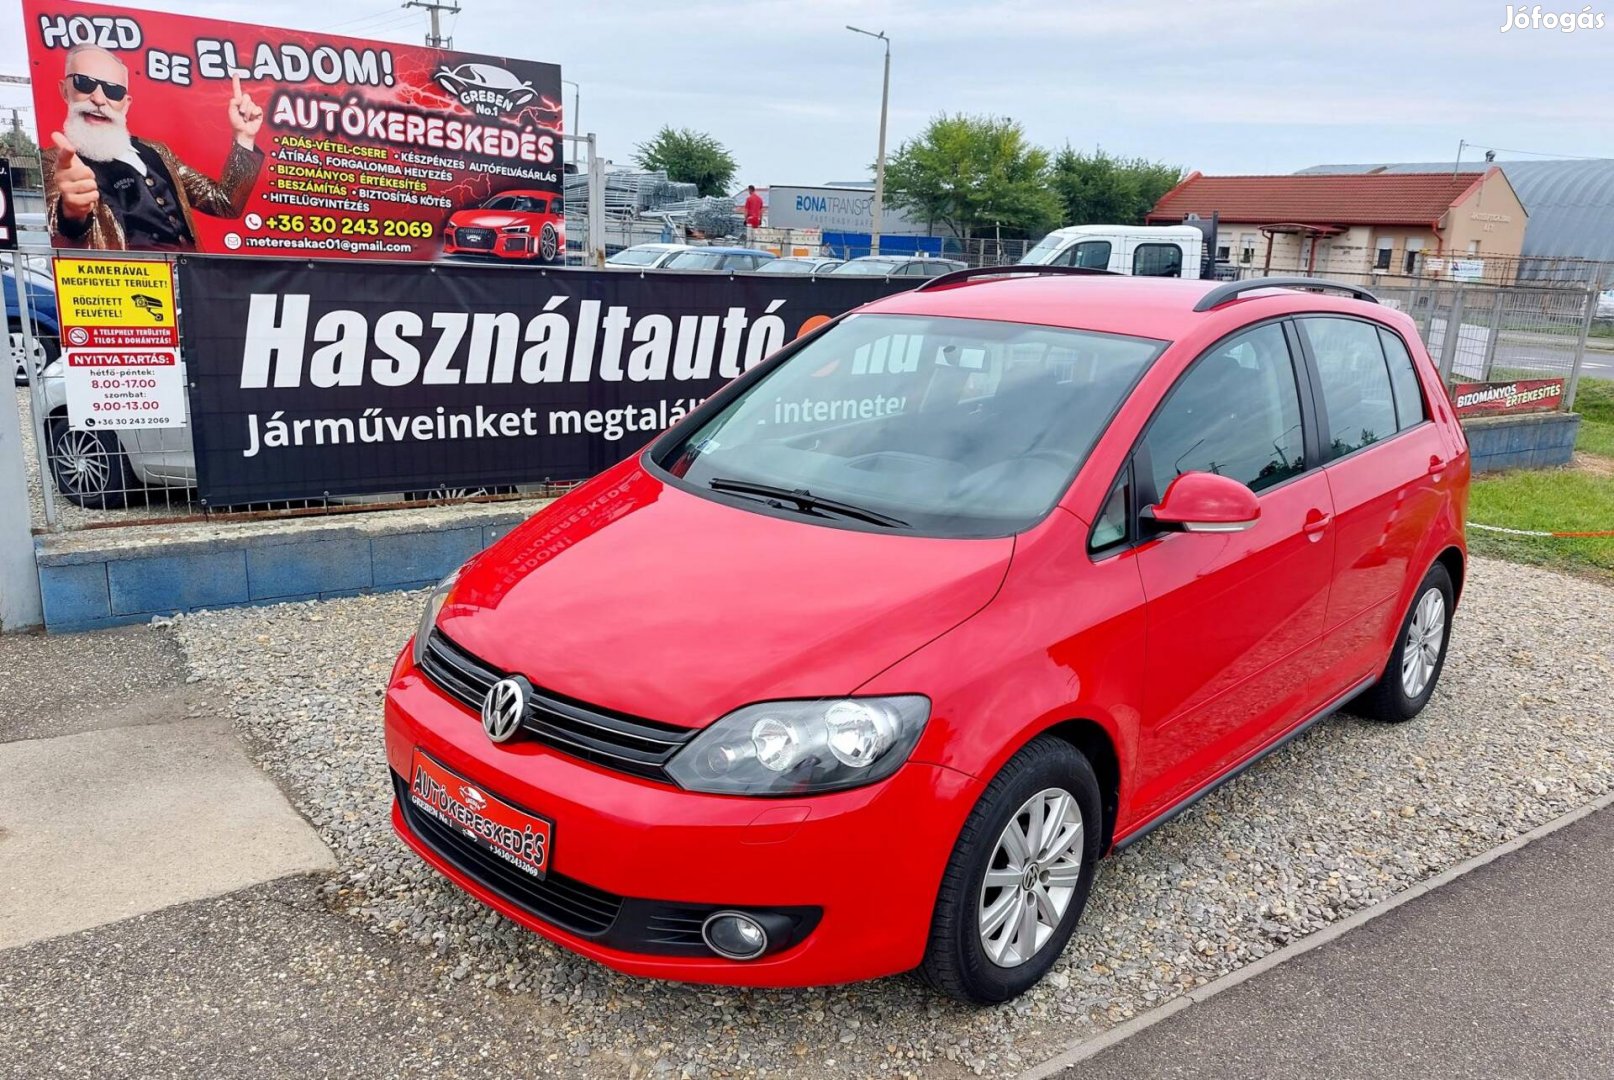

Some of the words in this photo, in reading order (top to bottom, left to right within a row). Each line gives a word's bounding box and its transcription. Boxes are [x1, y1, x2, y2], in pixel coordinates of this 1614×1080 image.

[40, 15, 142, 49] HOZD
[148, 50, 191, 85] BE
[196, 39, 394, 86] ELADOM!
[460, 90, 514, 112] GREBEN
[476, 103, 499, 117] No.1
[273, 94, 556, 165] AUTÓKERESKEDÉS
[281, 136, 388, 159] ADÁS-VÉTEL-CSERE
[278, 148, 323, 166] ÁTÍRÁS,
[325, 156, 402, 175] FORGALOMBA
[403, 167, 453, 182] HELYEZÉS
[400, 151, 466, 170] KÉSZPÉNZES
[468, 161, 558, 183] AUTÓFELVÁSÁRLÁS
[277, 164, 355, 183] BIZOMÁNYOS
[359, 173, 427, 192] ÉRTÉKESÍTÉS
[270, 192, 370, 212] HITELÜGYINTÉZÉS
[277, 179, 348, 196] BESZÁMÍTÁS
[358, 188, 418, 204] BIZTOSÍTÁS
[418, 194, 452, 208] KÖTÉS
[266, 214, 305, 233] +36
[308, 216, 337, 234] 30
[341, 218, 379, 235] 243
[383, 220, 433, 238] 2069
[77, 264, 150, 276] KAMERÁVAL
[61, 277, 121, 287] MEGFIGYELT
[125, 278, 168, 288] TERÜLET!
[72, 295, 123, 306] RÖGZÍTETT
[124, 336, 172, 344] DOHÁNYZÁS!
[136, 328, 171, 336] TERÜLETÉN
[239, 293, 787, 389] Használtautó
[74, 354, 121, 365] NYITVA
[121, 353, 170, 365] TARTÁS:
[91, 379, 156, 389] 8.00-17.00
[104, 391, 147, 399] szombat:
[92, 401, 159, 411] 9.00-13.00
[1456, 384, 1517, 409] BIZOMÁNYOS
[129, 417, 146, 425] 243
[243, 405, 538, 457] Járműveinket
[774, 395, 906, 424] internete
[413, 765, 546, 867] AUTÓKERESKEDÉS
